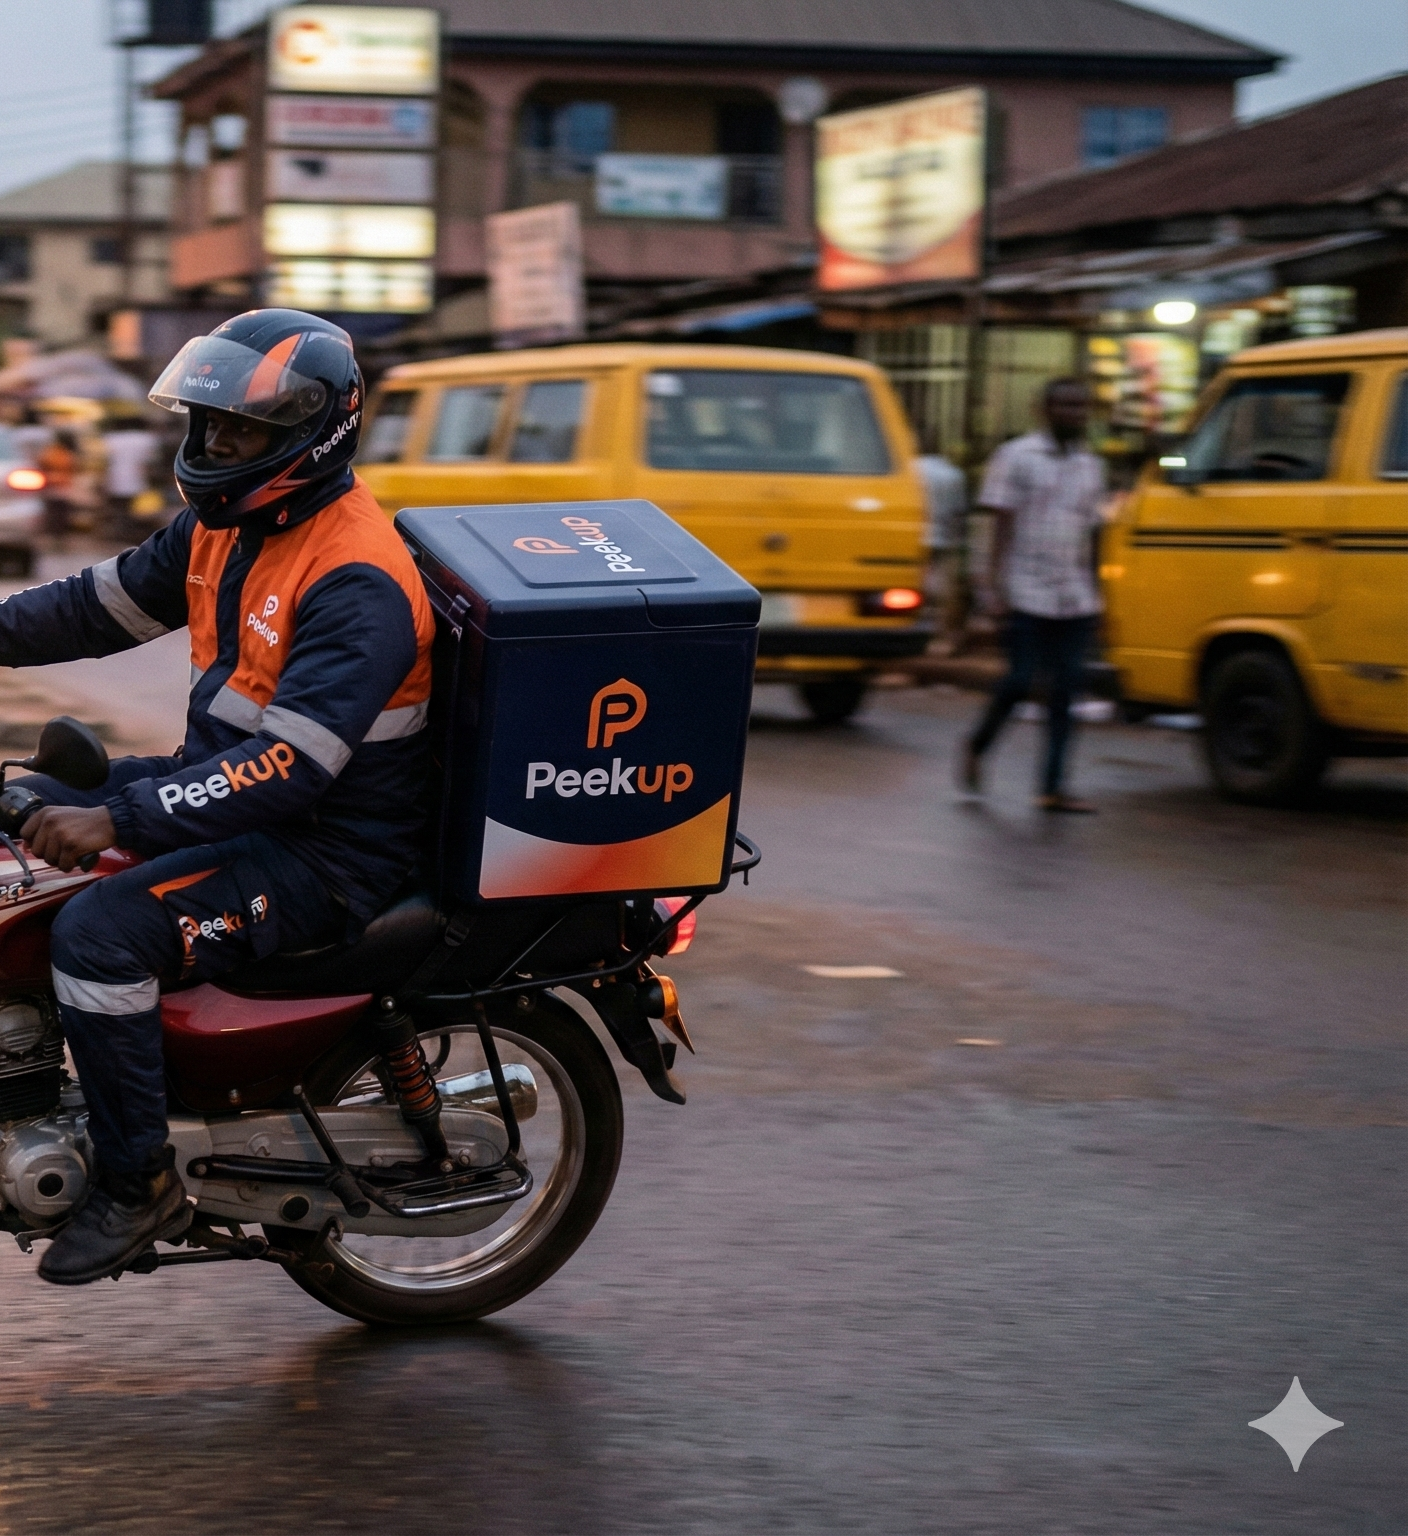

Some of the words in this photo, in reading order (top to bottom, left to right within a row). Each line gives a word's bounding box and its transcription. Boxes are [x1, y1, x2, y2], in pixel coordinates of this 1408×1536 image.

[561, 516, 645, 572] Peekup
[158, 742, 295, 814] Peekup
[526, 757, 694, 803] Peekup
